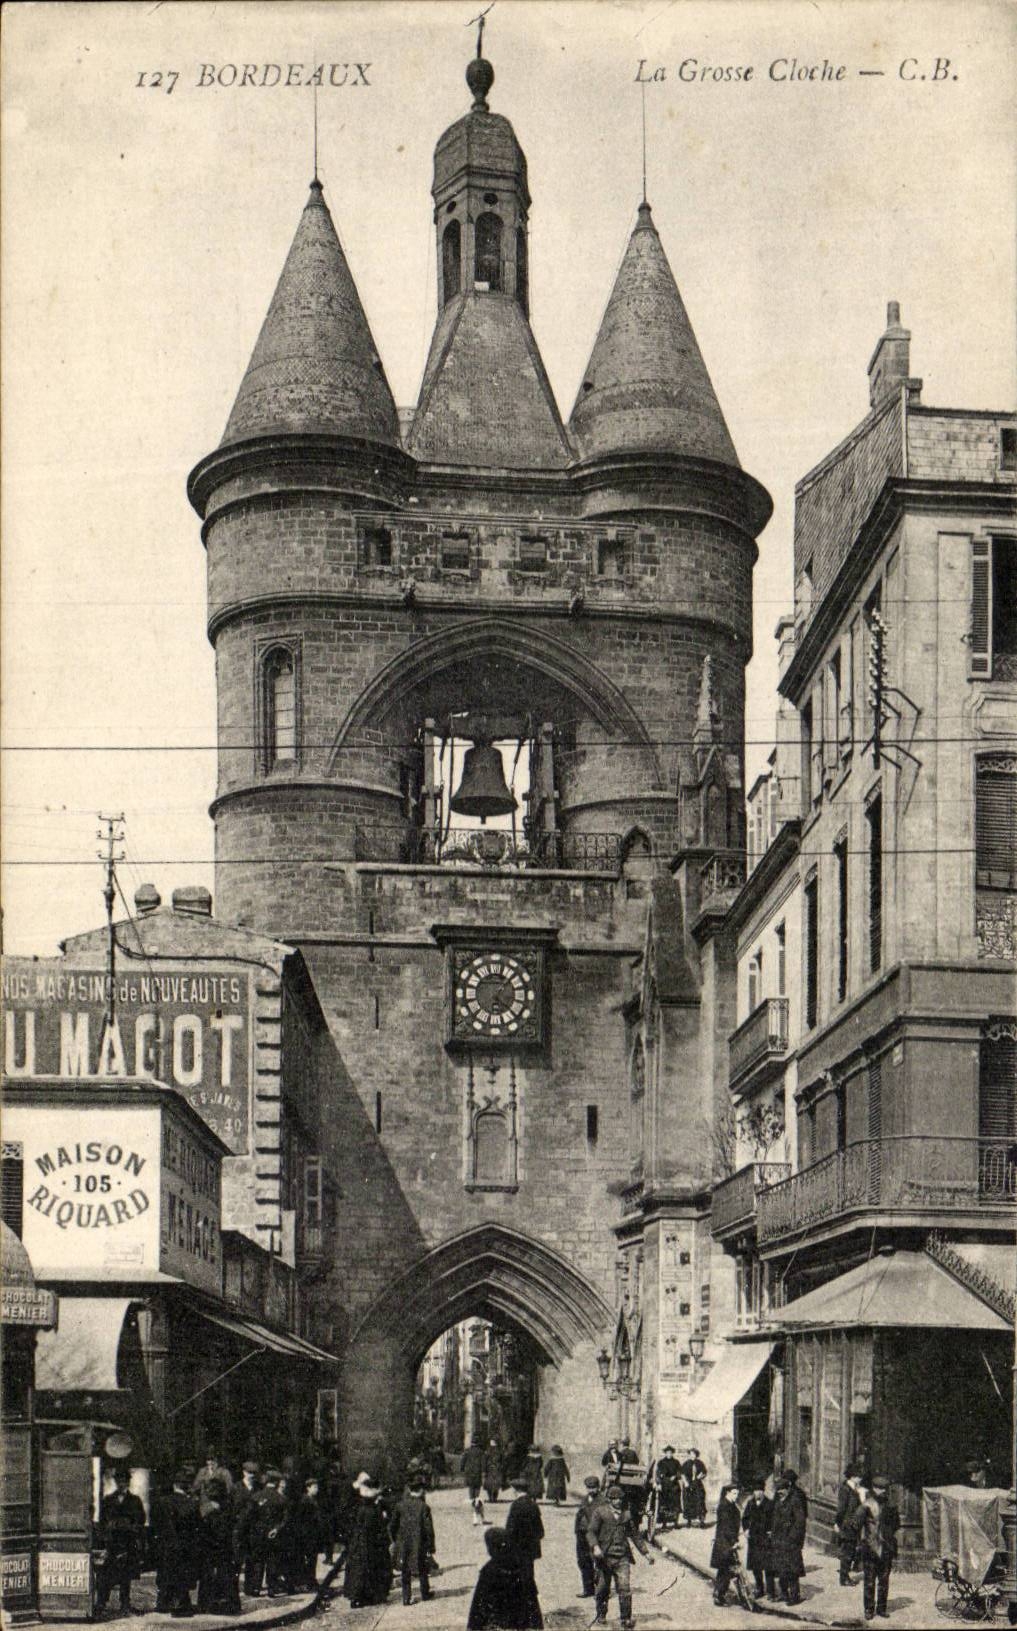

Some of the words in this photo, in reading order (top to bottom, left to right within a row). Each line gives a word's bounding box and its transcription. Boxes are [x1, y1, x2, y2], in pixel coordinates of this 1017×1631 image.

[120, 979, 138, 1002] de
[141, 977, 240, 1003] NOUVEAUTES
[60, 1011, 244, 1087] MAGOT
[34, 1142, 146, 1177] MAISON
[73, 1174, 112, 1193] 105
[27, 1184, 150, 1229] RIQUARD
[1, 1306, 48, 1320] MENIER
[41, 1559, 87, 1573] CHOCOLAT
[42, 1575, 85, 1589] MENIER
